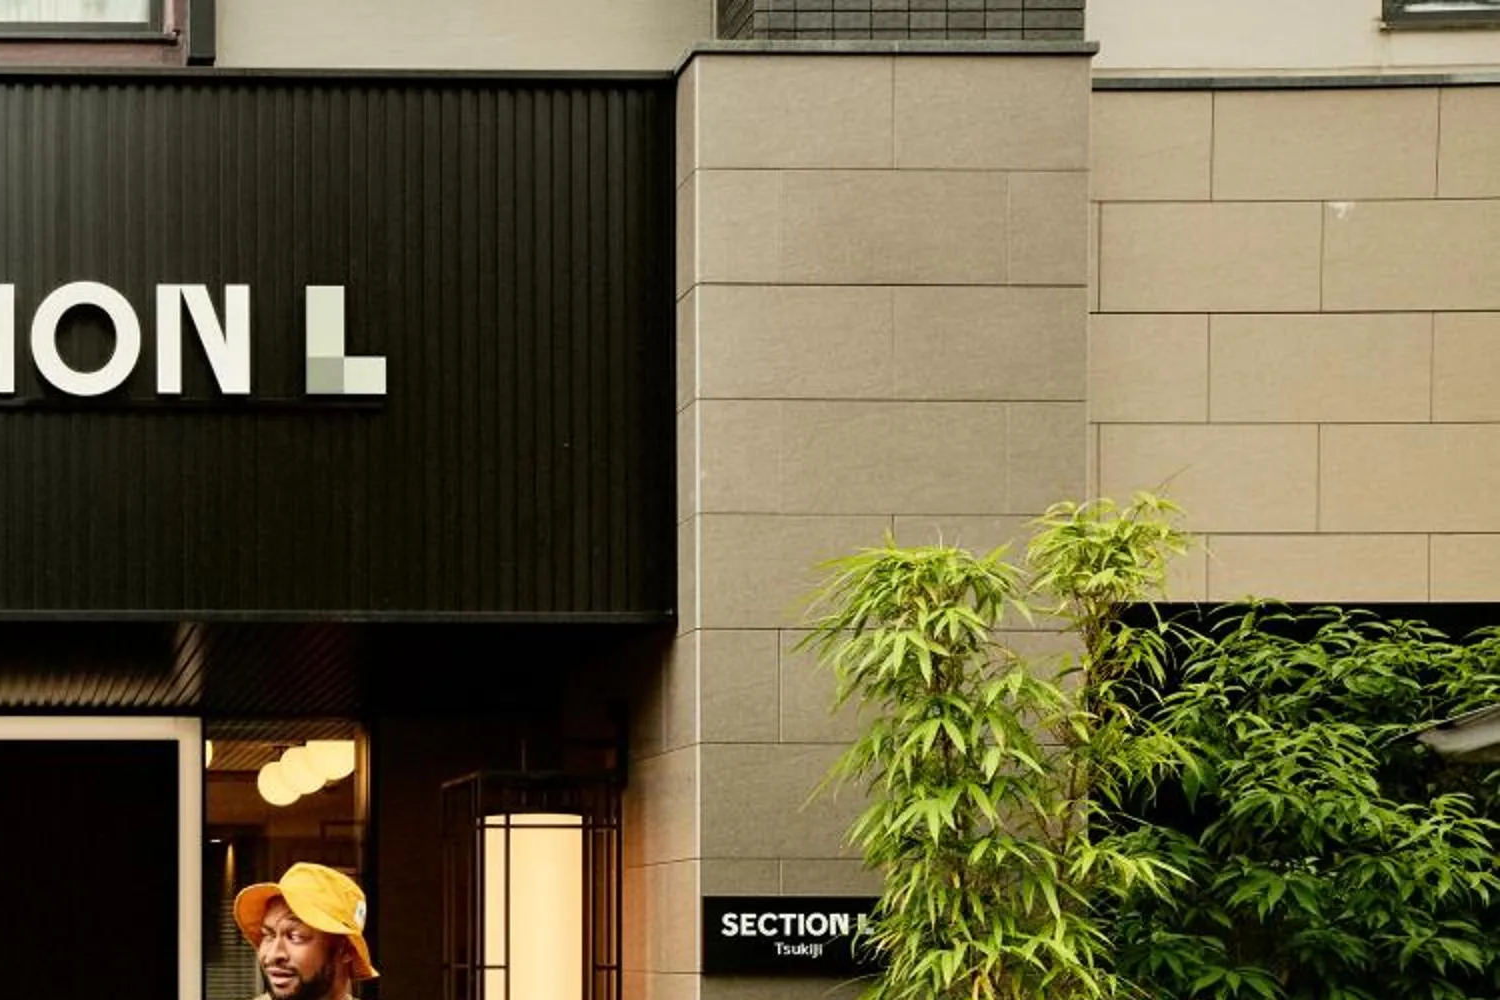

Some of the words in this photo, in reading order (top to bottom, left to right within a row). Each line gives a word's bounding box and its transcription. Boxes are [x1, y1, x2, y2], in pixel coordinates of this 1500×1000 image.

[306, 285, 387, 394] L
[720, 912, 850, 937] SECTION
[774, 942, 824, 959] Tsukiji
